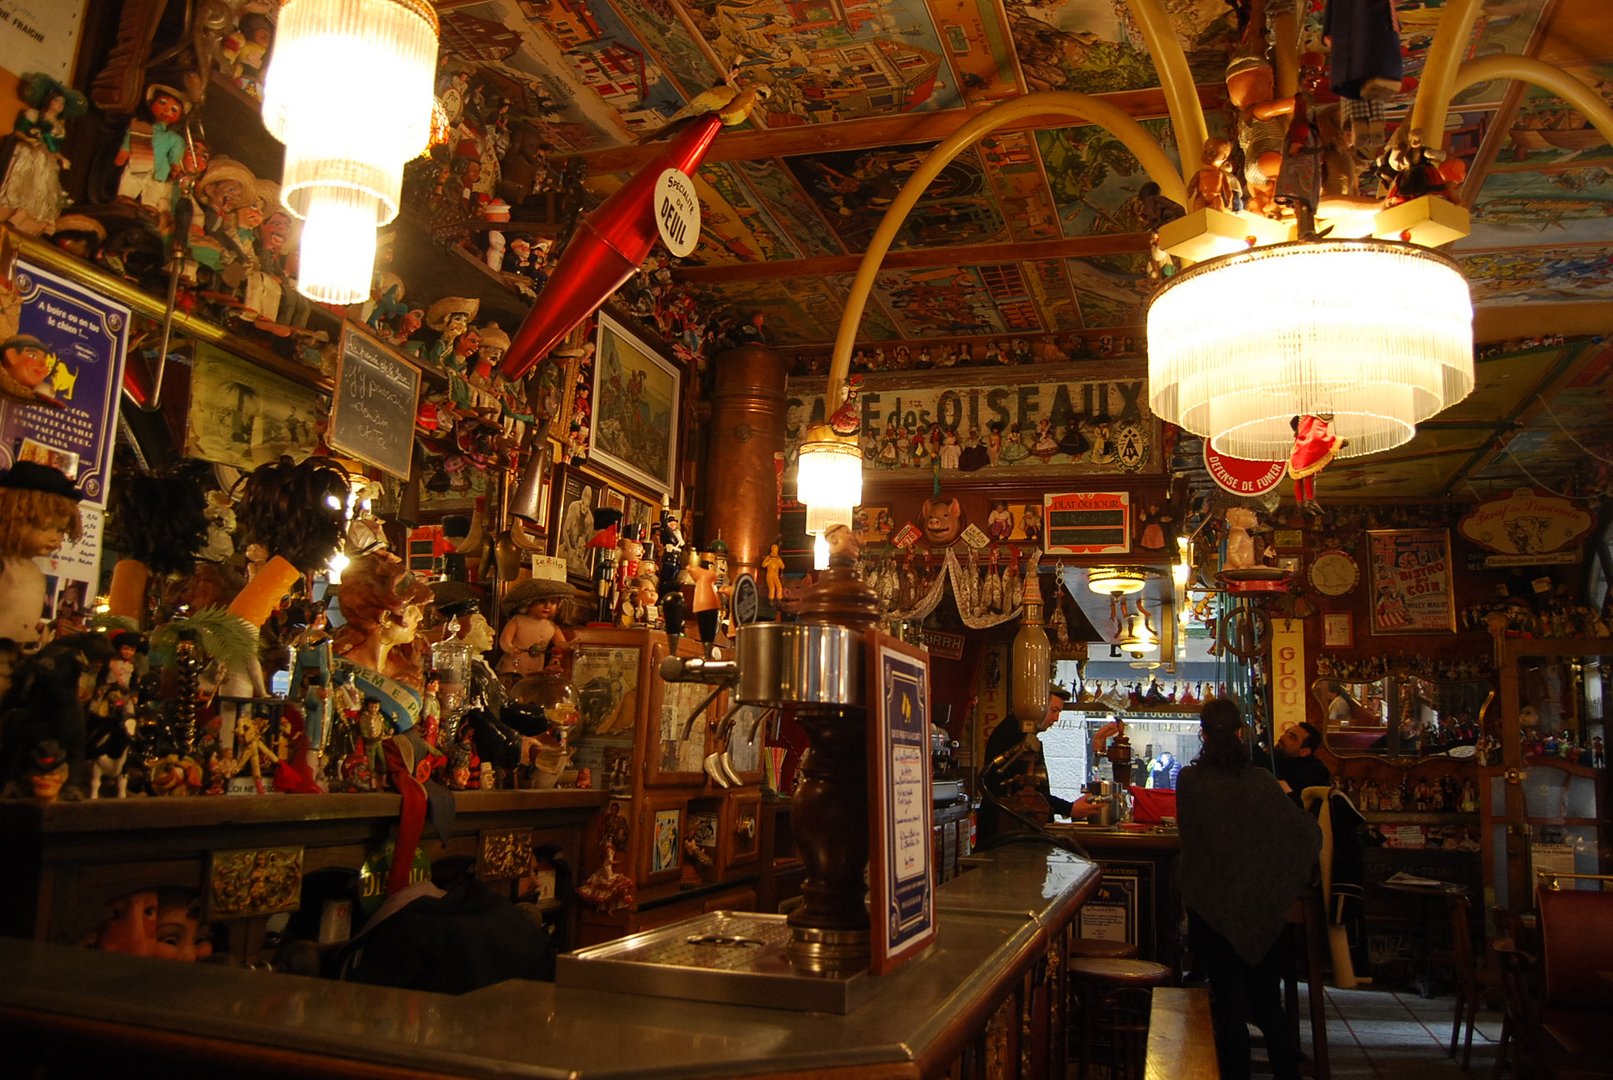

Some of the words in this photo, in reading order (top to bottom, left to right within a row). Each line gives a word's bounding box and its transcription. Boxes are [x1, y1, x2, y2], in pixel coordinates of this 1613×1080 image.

[676, 198, 684, 212] DE
[661, 196, 687, 245] DEUIL
[38, 302, 45, 310] A
[47, 303, 67, 318] boire
[68, 314, 78, 323] ou
[79, 318, 89, 328] on
[48, 316, 56, 325] le
[57, 319, 77, 335] chien
[785, 393, 881, 439] CAE
[888, 396, 931, 432] des
[937, 380, 1145, 432] OISEAUX
[1209, 456, 1239, 488] DEFENSE
[1242, 481, 1254, 491] DE
[1257, 464, 1282, 489] FUMER
[1399, 562, 1444, 582] BISTRO
[1406, 581, 1440, 596] COIN
